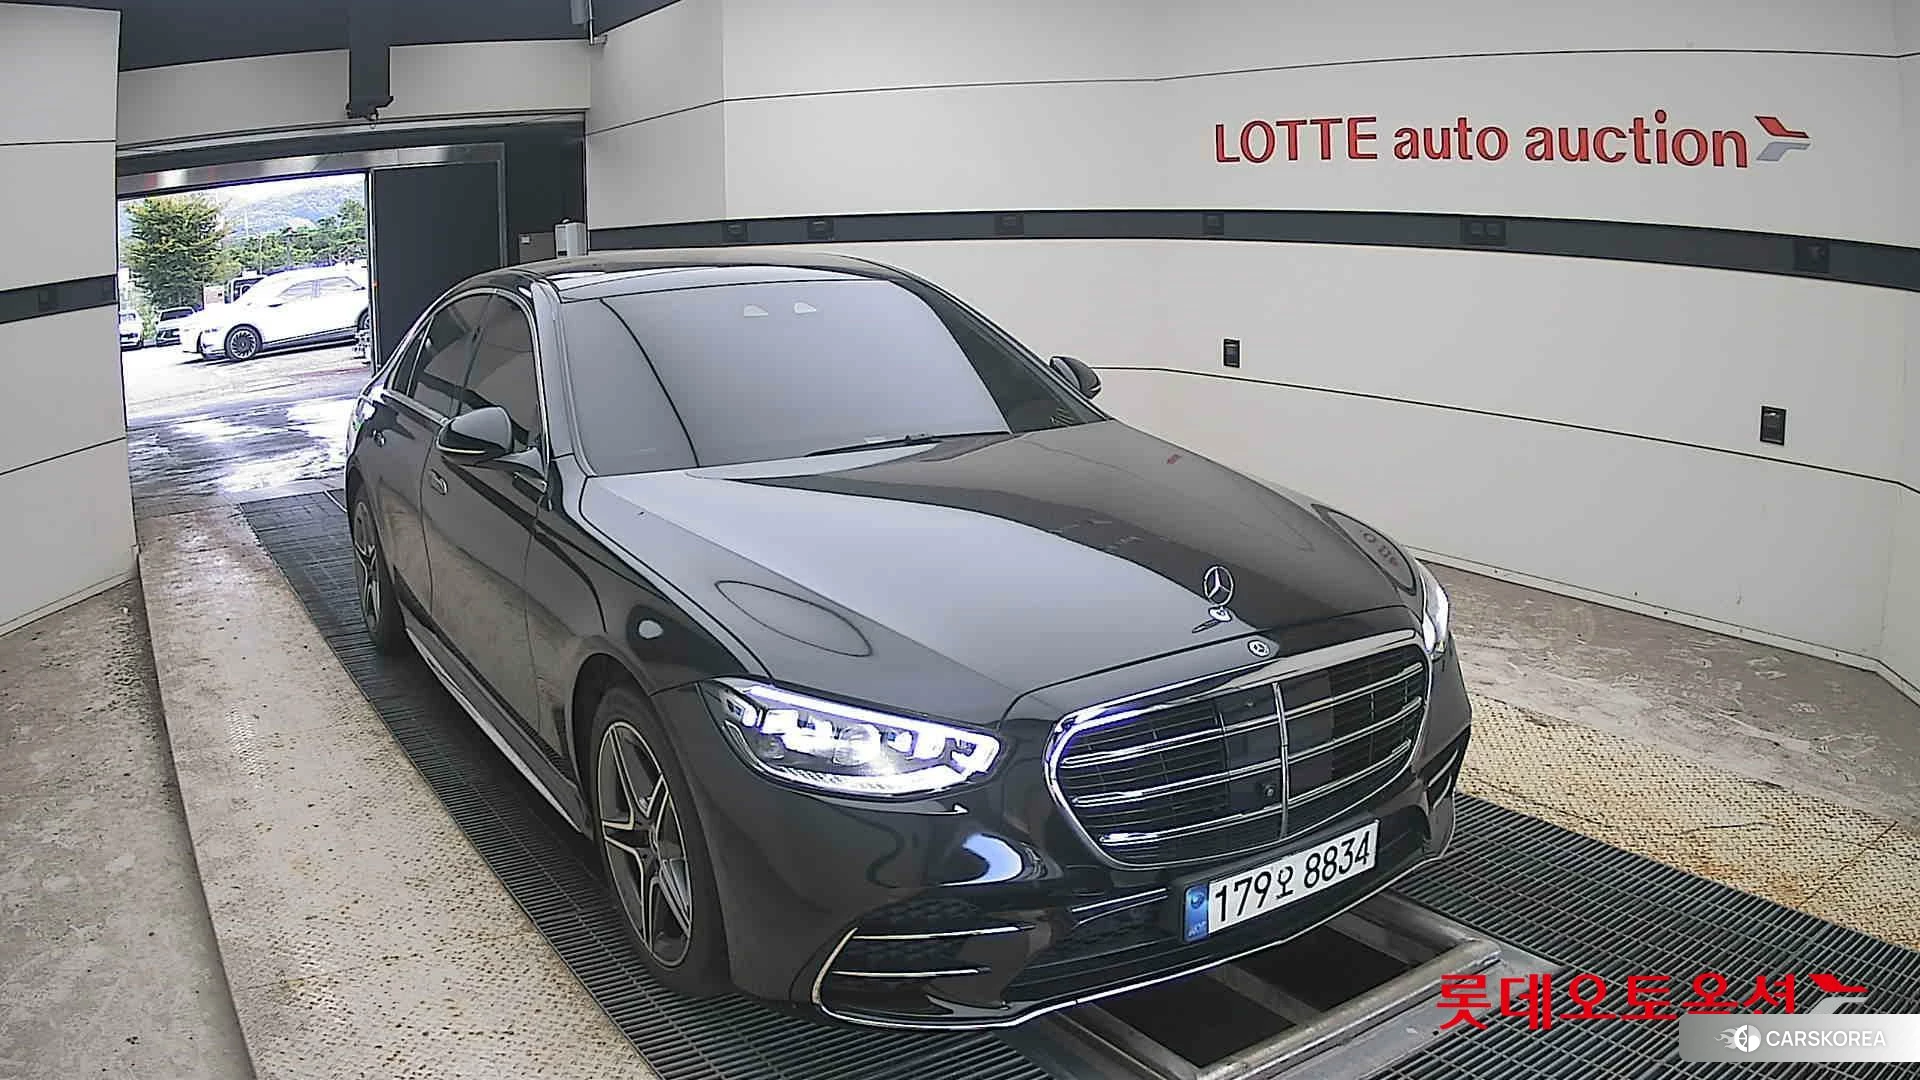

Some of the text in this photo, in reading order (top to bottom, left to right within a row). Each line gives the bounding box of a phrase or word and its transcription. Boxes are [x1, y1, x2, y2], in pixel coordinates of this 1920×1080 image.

[1215, 110, 1749, 169] LOTTE auto auction
[1303, 831, 1370, 889] 8834
